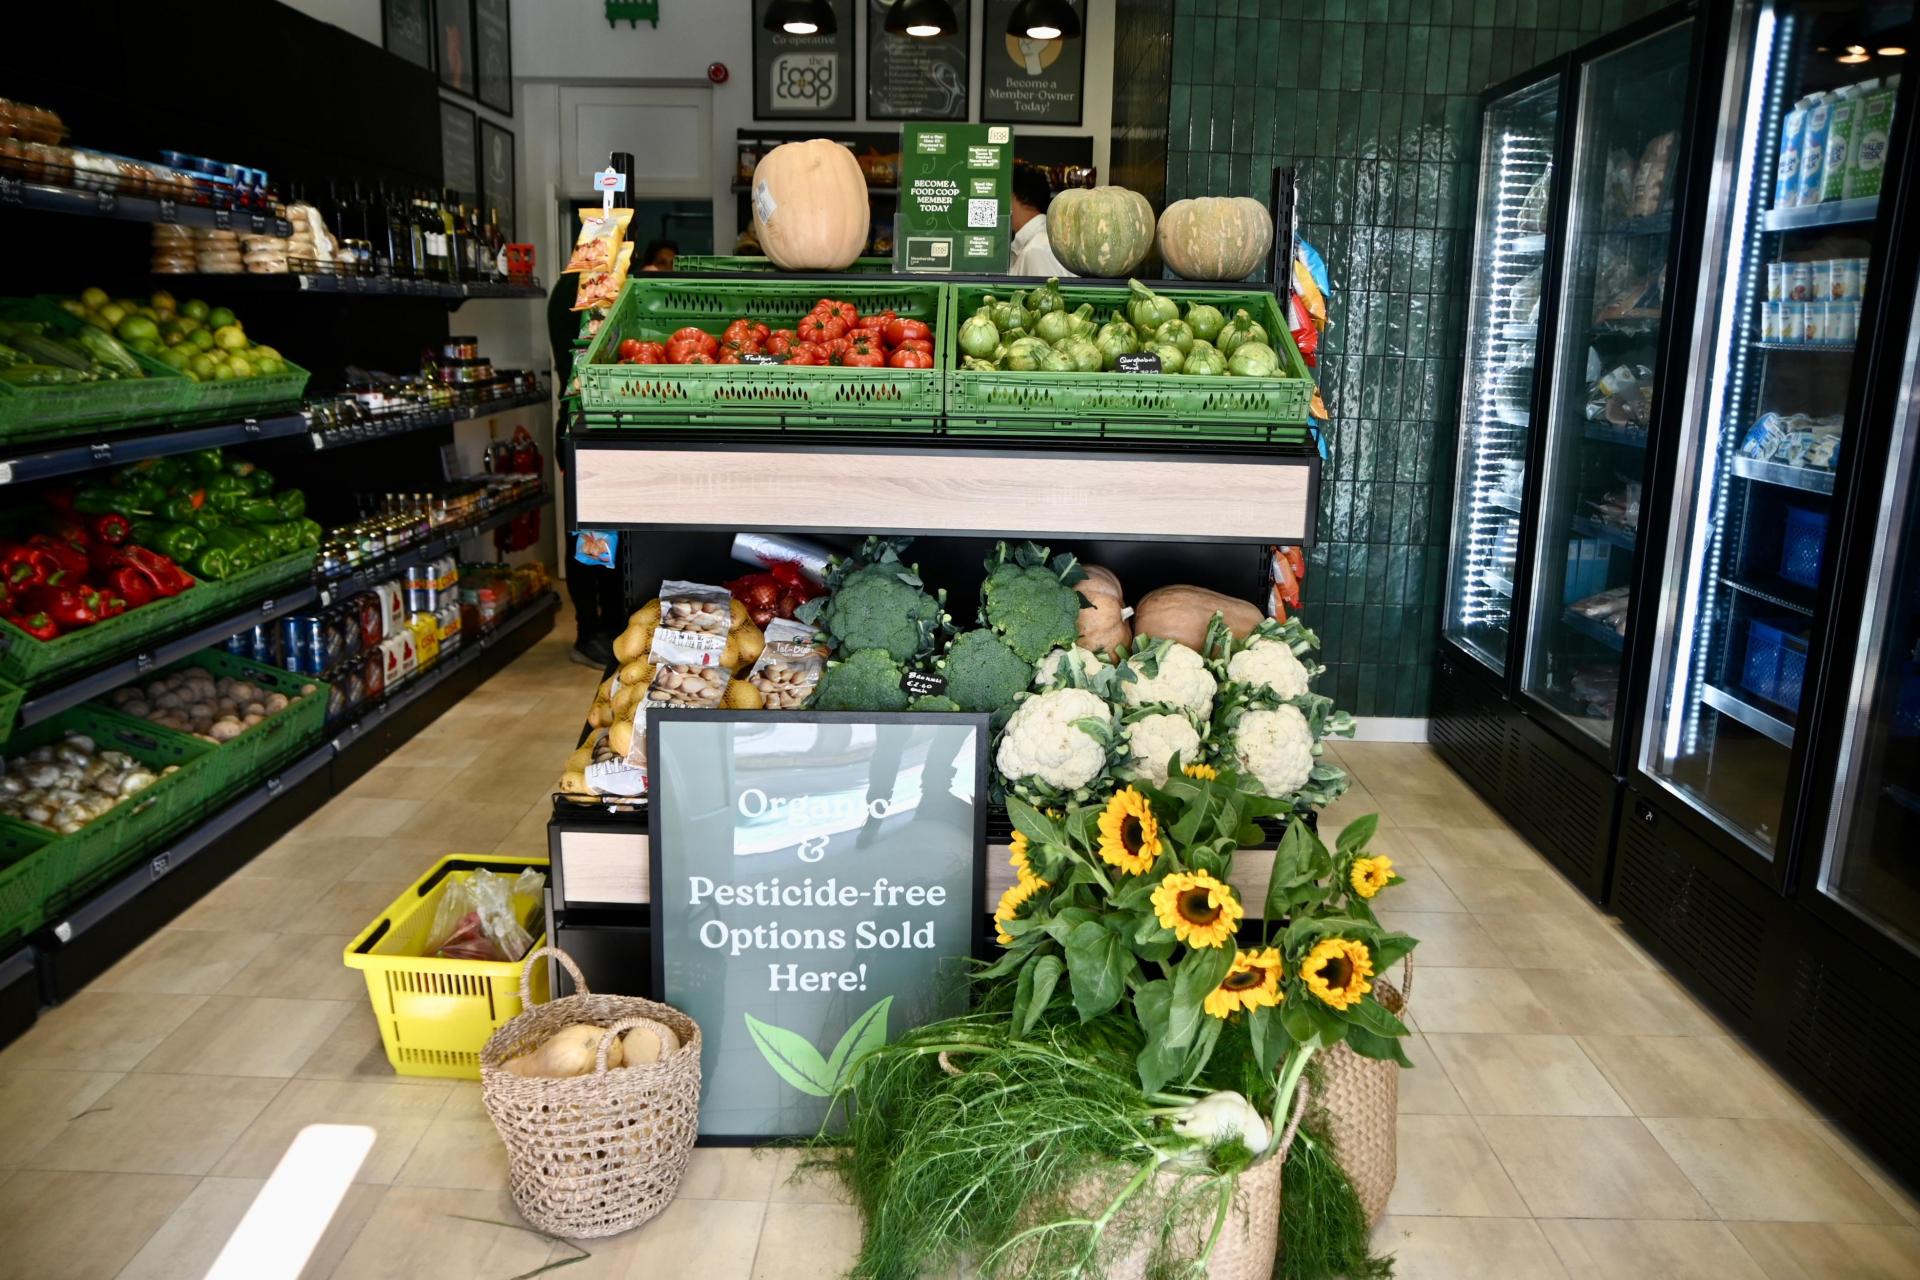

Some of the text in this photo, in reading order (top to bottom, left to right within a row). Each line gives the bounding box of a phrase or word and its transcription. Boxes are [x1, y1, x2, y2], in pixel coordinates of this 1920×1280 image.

[809, 56, 824, 65] the
[780, 59, 832, 84] food
[1006, 77, 1048, 88] Become
[777, 81, 832, 107] coop
[1014, 101, 1050, 114] Today!
[910, 188, 960, 196] FOOD COOP
[914, 180, 957, 188] BECOME A
[917, 196, 953, 204] MEMBER
[920, 204, 950, 212] TODAY
[738, 788, 892, 826] Organic
[797, 833, 830, 863] &
[688, 876, 947, 908] Pesticide-free
[699, 920, 936, 957] Options Sold
[768, 963, 868, 993] Here!
